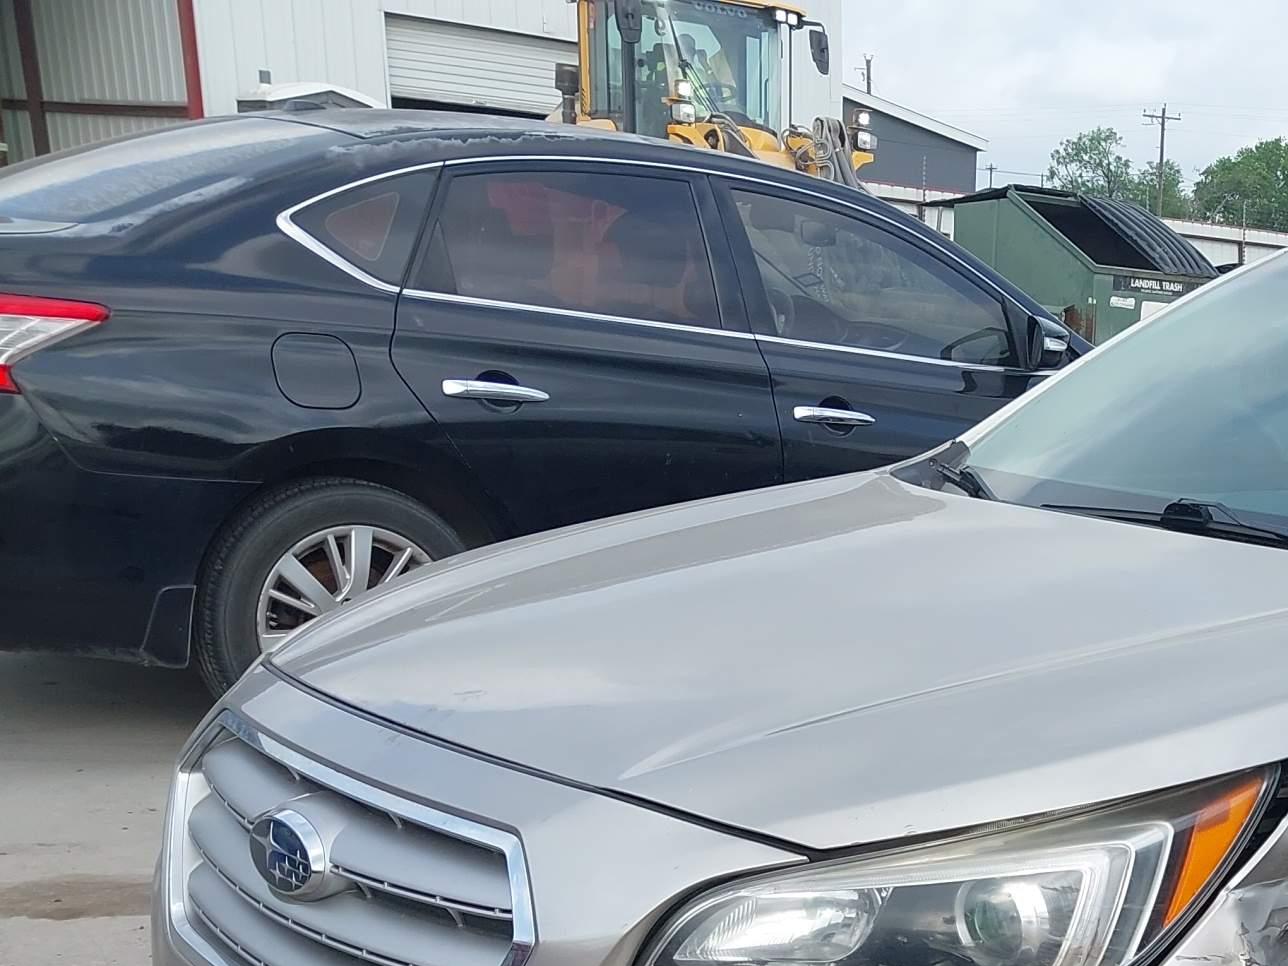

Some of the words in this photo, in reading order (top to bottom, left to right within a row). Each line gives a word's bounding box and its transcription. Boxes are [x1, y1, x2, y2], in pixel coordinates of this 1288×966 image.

[694, 1, 748, 18] VOLVO
[1130, 278, 1160, 290] LANDFILL
[1162, 281, 1183, 292] TRASH
